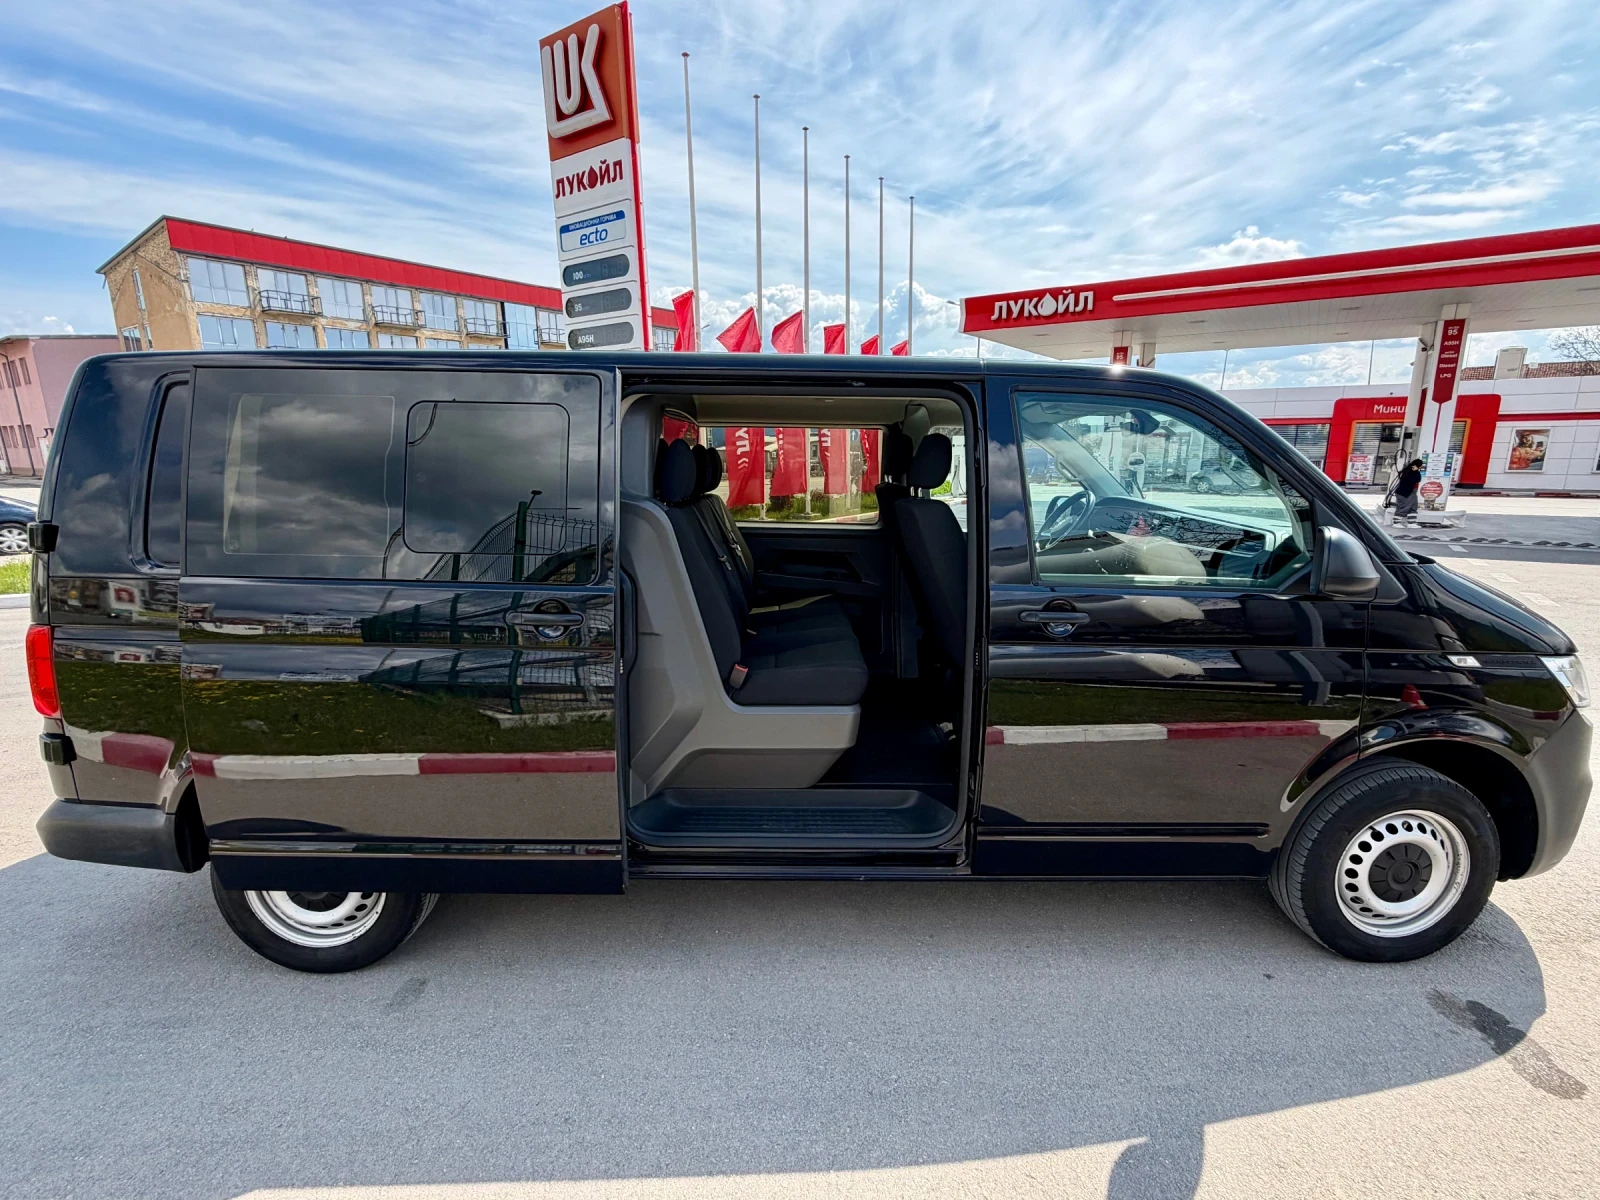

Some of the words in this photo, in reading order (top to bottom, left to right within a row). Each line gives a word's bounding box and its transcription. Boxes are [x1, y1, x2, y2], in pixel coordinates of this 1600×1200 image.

[555, 159, 624, 199] ЛУКОЙЛ
[579, 227, 608, 246] ecto
[572, 271, 584, 281] 100
[574, 303, 583, 312] 95
[990, 289, 1094, 321] ЛУКОЙЛ
[1373, 404, 1408, 414] Мини
